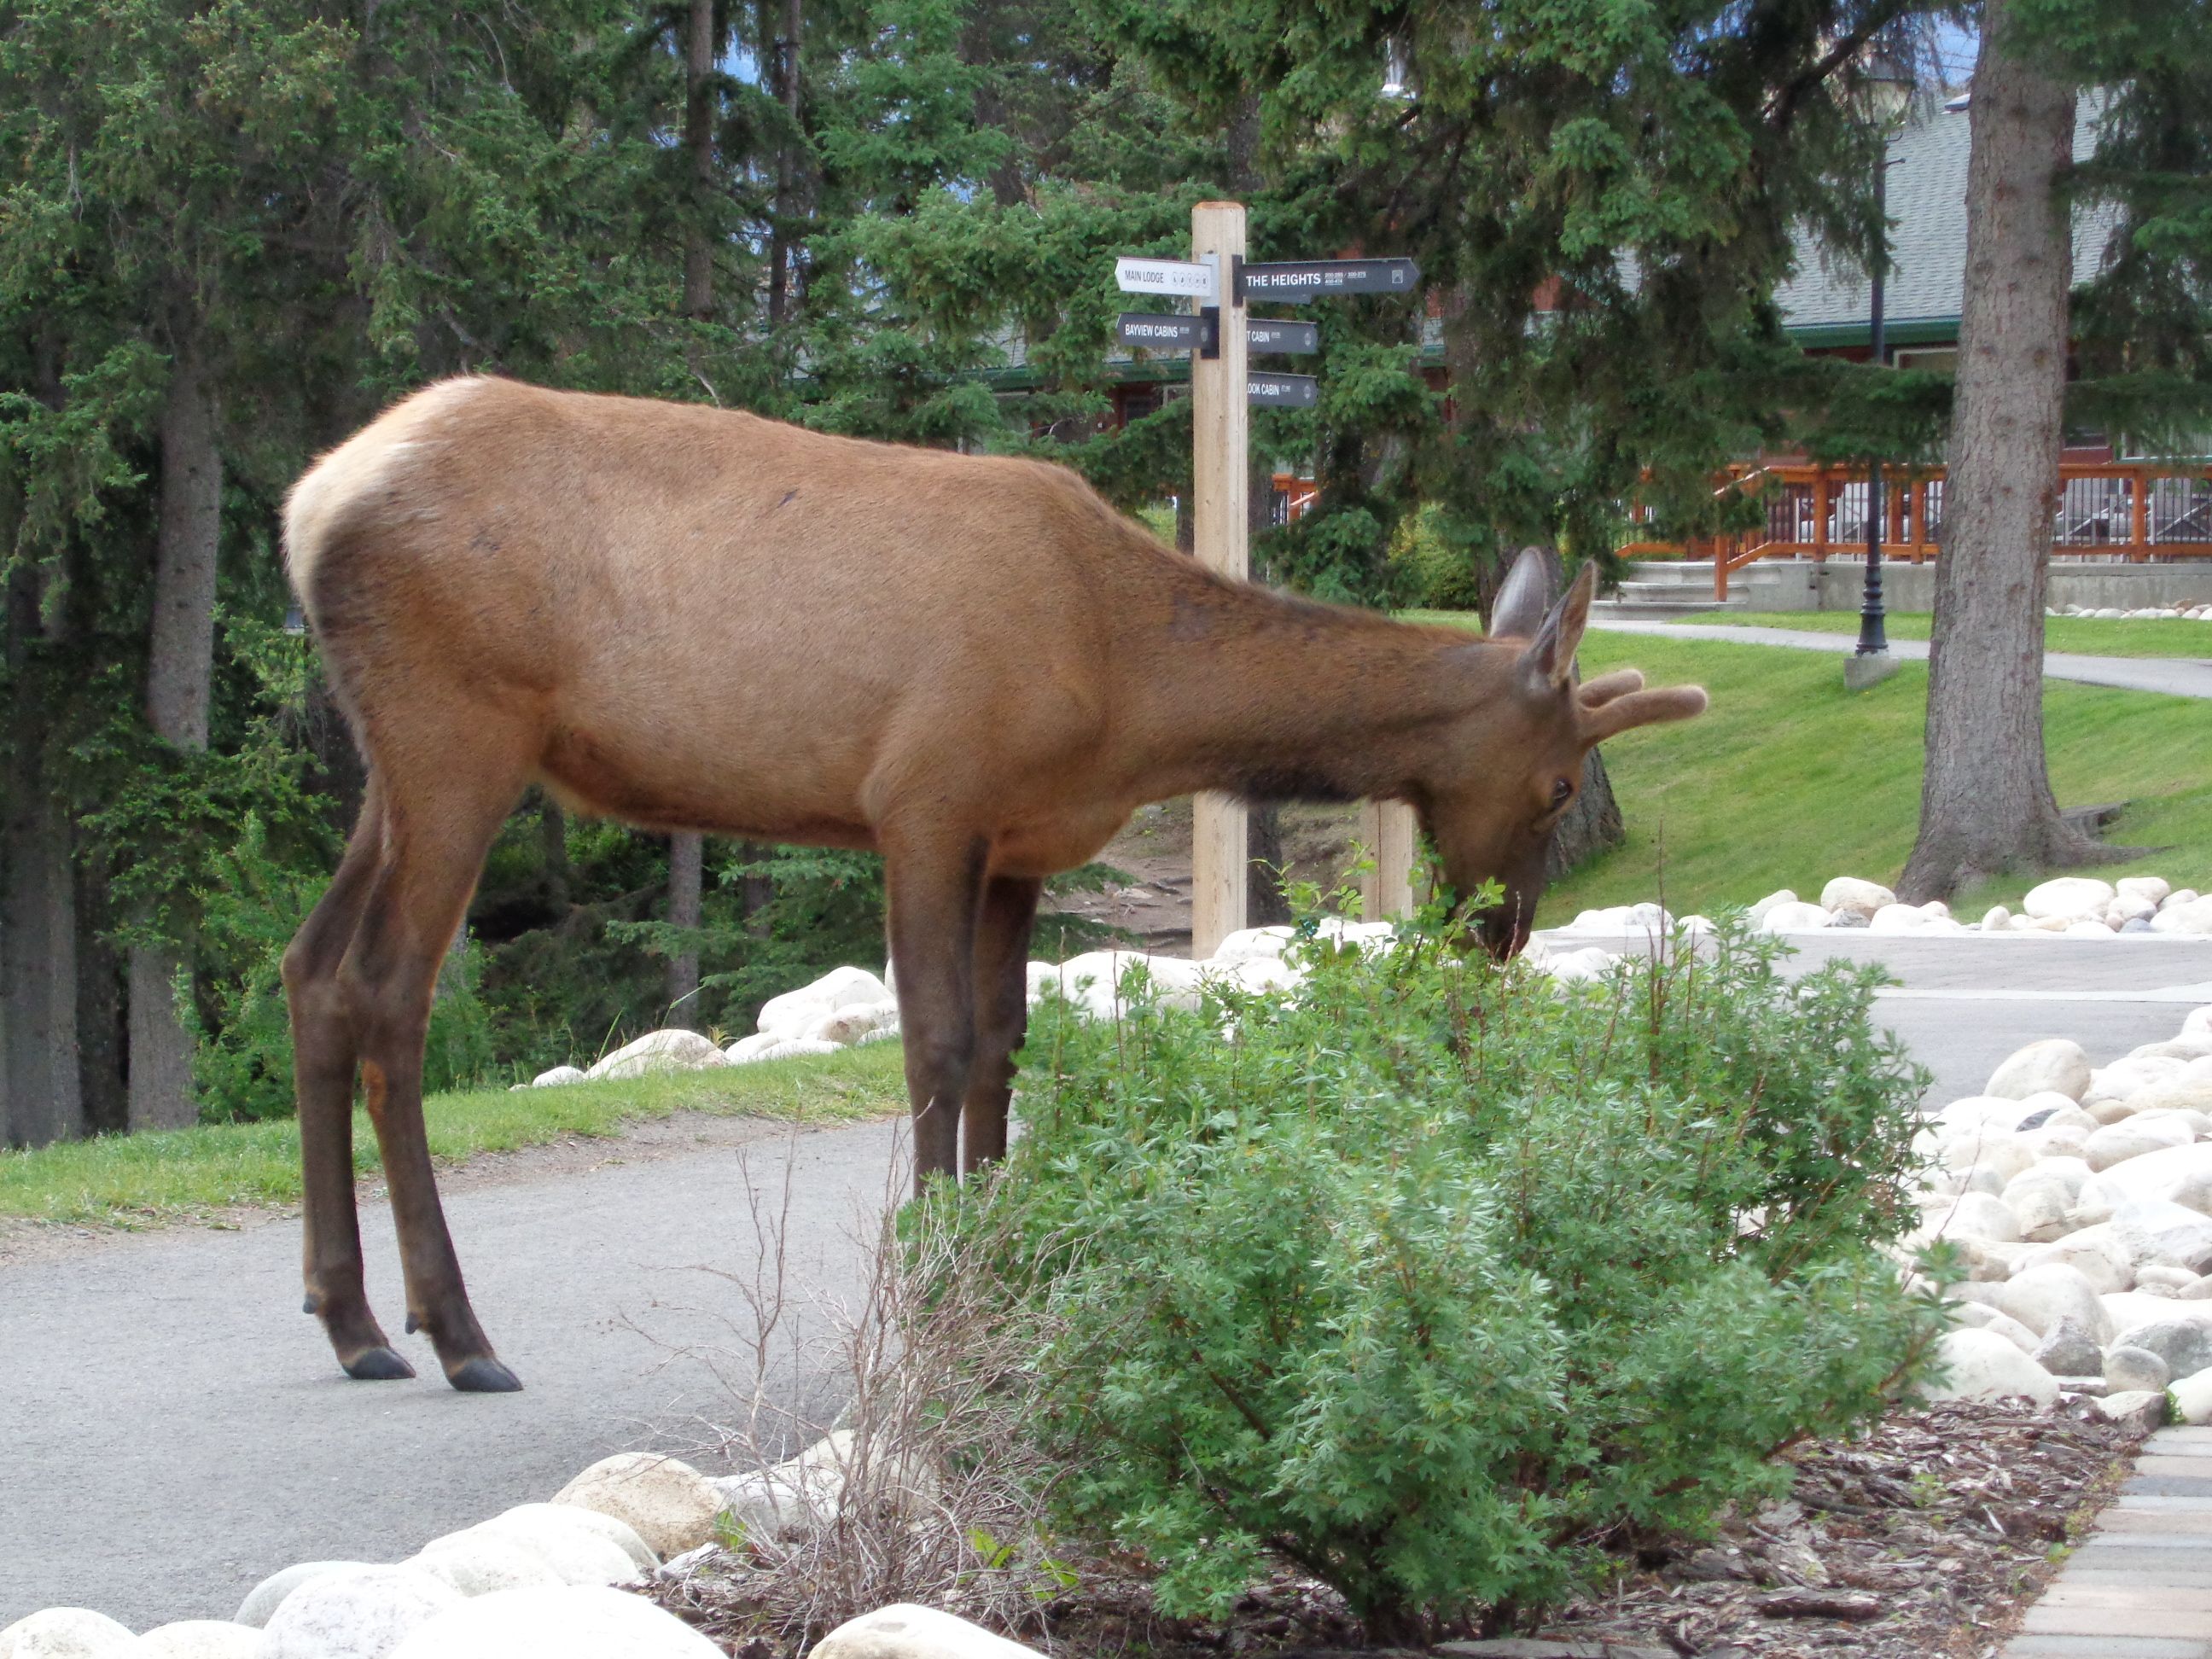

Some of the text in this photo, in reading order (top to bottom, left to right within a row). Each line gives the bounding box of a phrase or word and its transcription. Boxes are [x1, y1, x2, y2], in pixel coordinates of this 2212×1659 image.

[1125, 270, 1164, 283] MAIN LODGE
[1246, 273, 1322, 287] THE HEIGHTS
[1125, 323, 1153, 336] BAYVIEW
[1154, 325, 1178, 338] CABINS
[1251, 330, 1270, 342] CABIN
[1247, 382, 1260, 394] OOK
[1260, 384, 1279, 395] CABIN
